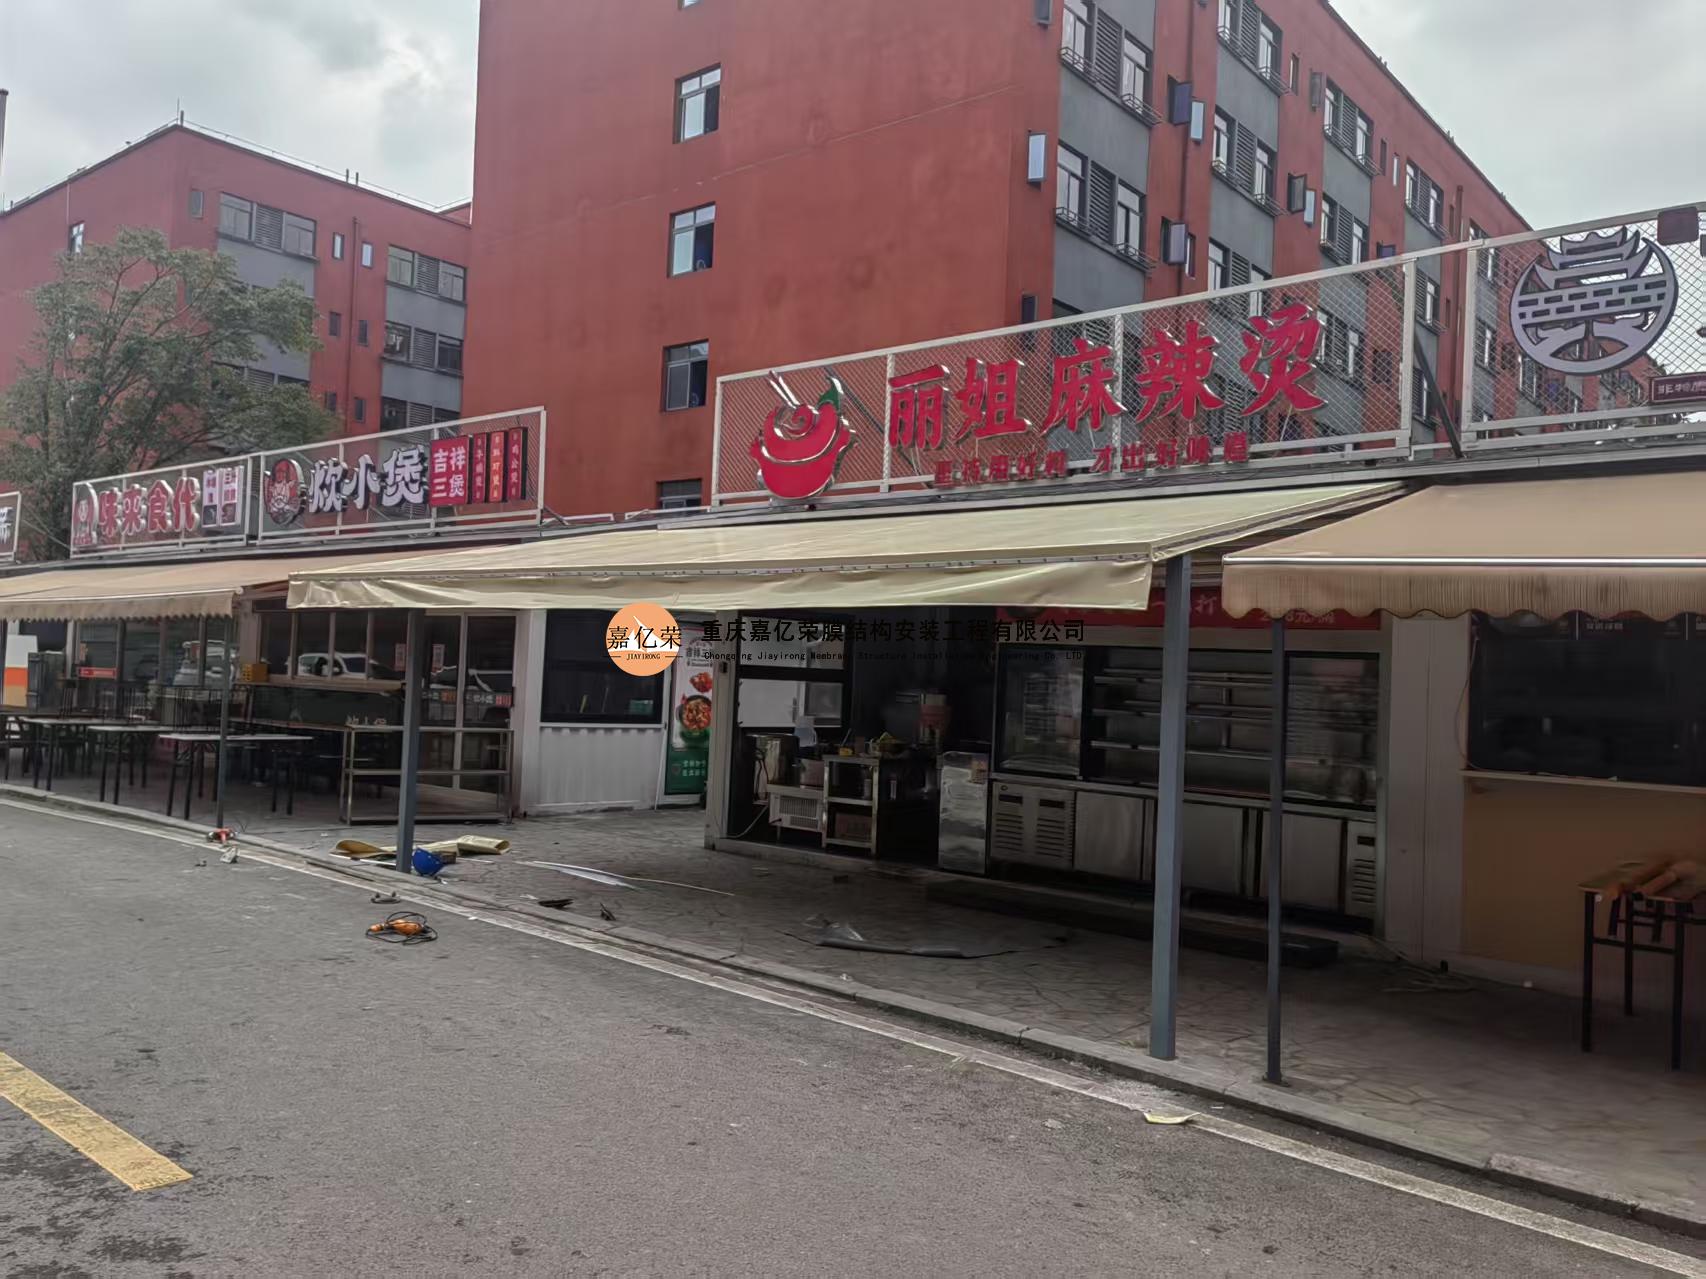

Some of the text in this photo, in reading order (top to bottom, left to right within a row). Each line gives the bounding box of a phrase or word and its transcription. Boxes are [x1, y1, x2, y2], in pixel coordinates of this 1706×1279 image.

[888, 303, 1327, 449] 丽姐麻辣烫
[308, 444, 425, 513] 炊小煲
[432, 475, 465, 498] 三煲
[433, 446, 466, 473] 吉祥
[98, 477, 200, 537] 味来食代
